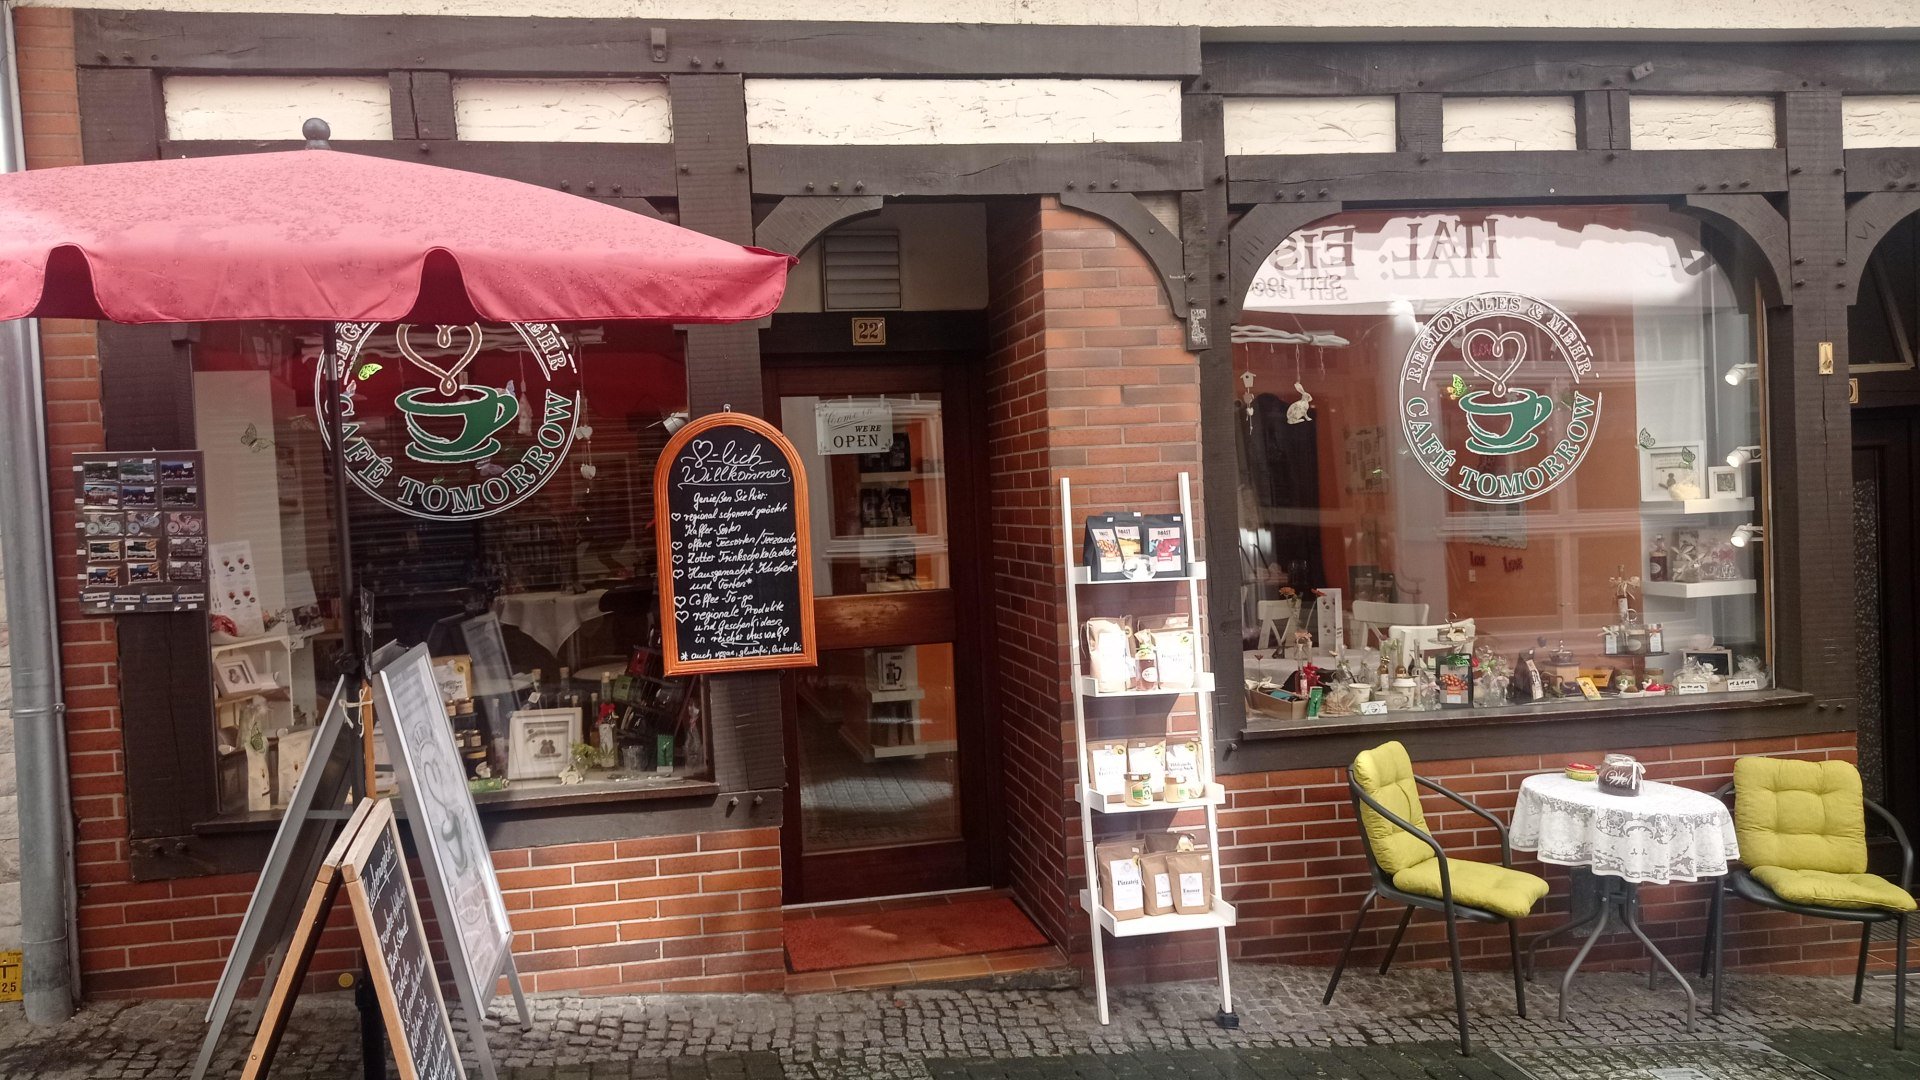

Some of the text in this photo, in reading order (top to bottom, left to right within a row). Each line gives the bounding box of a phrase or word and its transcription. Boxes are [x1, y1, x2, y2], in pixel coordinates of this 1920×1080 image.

[858, 322, 879, 339] 22
[1406, 296, 1592, 383] REGIONALES & MEHR
[855, 424, 882, 432] WE'RE
[833, 434, 879, 448] OPEN
[1406, 391, 1595, 497] CAFÉ TOMORROW
[397, 389, 572, 513] TOMORROW
[682, 465, 787, 483] Willkommen
[693, 491, 732, 511] Genießen
[734, 489, 748, 502] Sie
[683, 508, 718, 525] regional
[719, 507, 754, 521] schonend
[688, 538, 712, 551] offene
[687, 552, 716, 564] Zotter
[690, 581, 713, 590] und
[693, 601, 784, 625] regionale Produkte
[694, 621, 716, 631] und
[695, 633, 706, 643] in
[747, 627, 790, 641] Auswahl
[690, 650, 712, 660] auch
